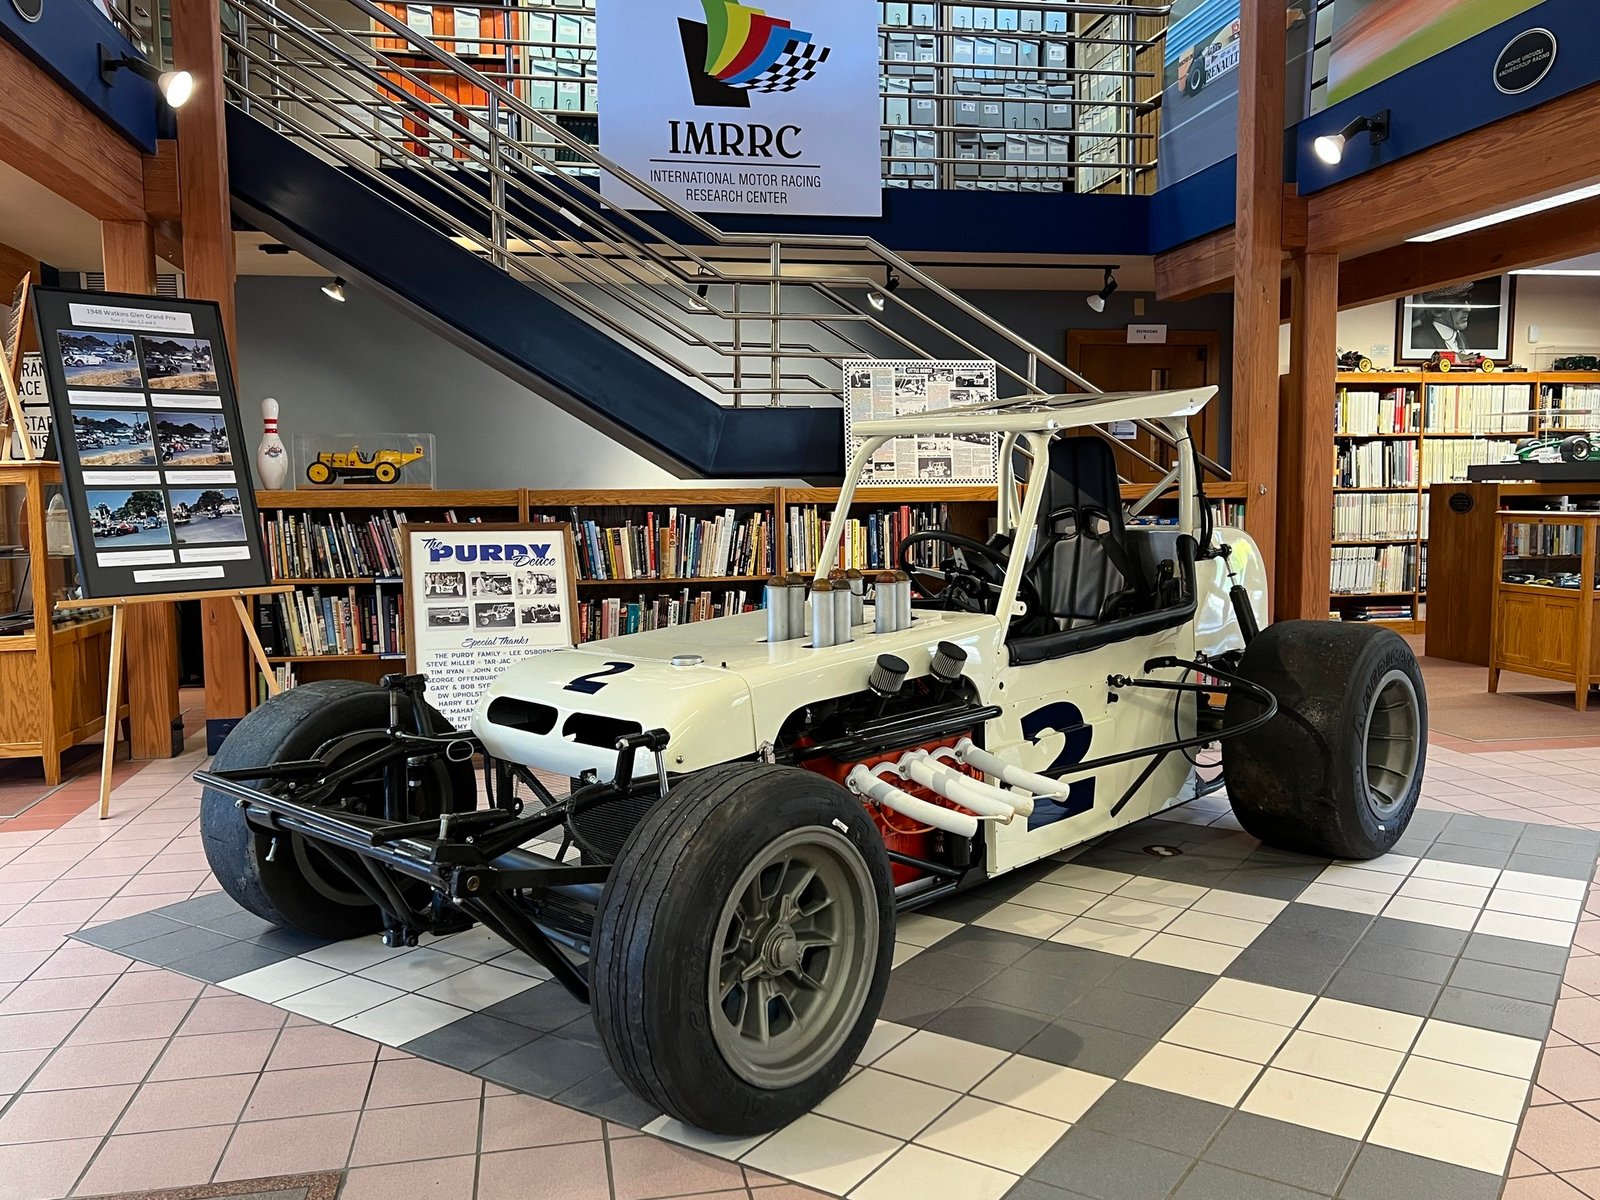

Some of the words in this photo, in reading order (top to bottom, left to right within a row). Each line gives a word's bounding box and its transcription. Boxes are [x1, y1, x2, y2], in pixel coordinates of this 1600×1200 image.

[1205, 51, 1239, 80] RENAULT
[1532, 51, 1550, 63] RACING
[668, 120, 802, 158] IMRRC
[650, 170, 735, 185] INTERNATIONAL
[738, 172, 778, 187] MOTOR
[781, 174, 821, 188] RACING
[686, 189, 743, 203] RESEARCH
[746, 190, 788, 204] CENTER
[421, 538, 442, 550] The
[430, 544, 552, 562] PURDY
[512, 554, 556, 567] Deuce
[462, 638, 497, 648] Special
[498, 636, 529, 646] Thanks
[562, 661, 635, 695] 2
[1020, 701, 1096, 833] 2
